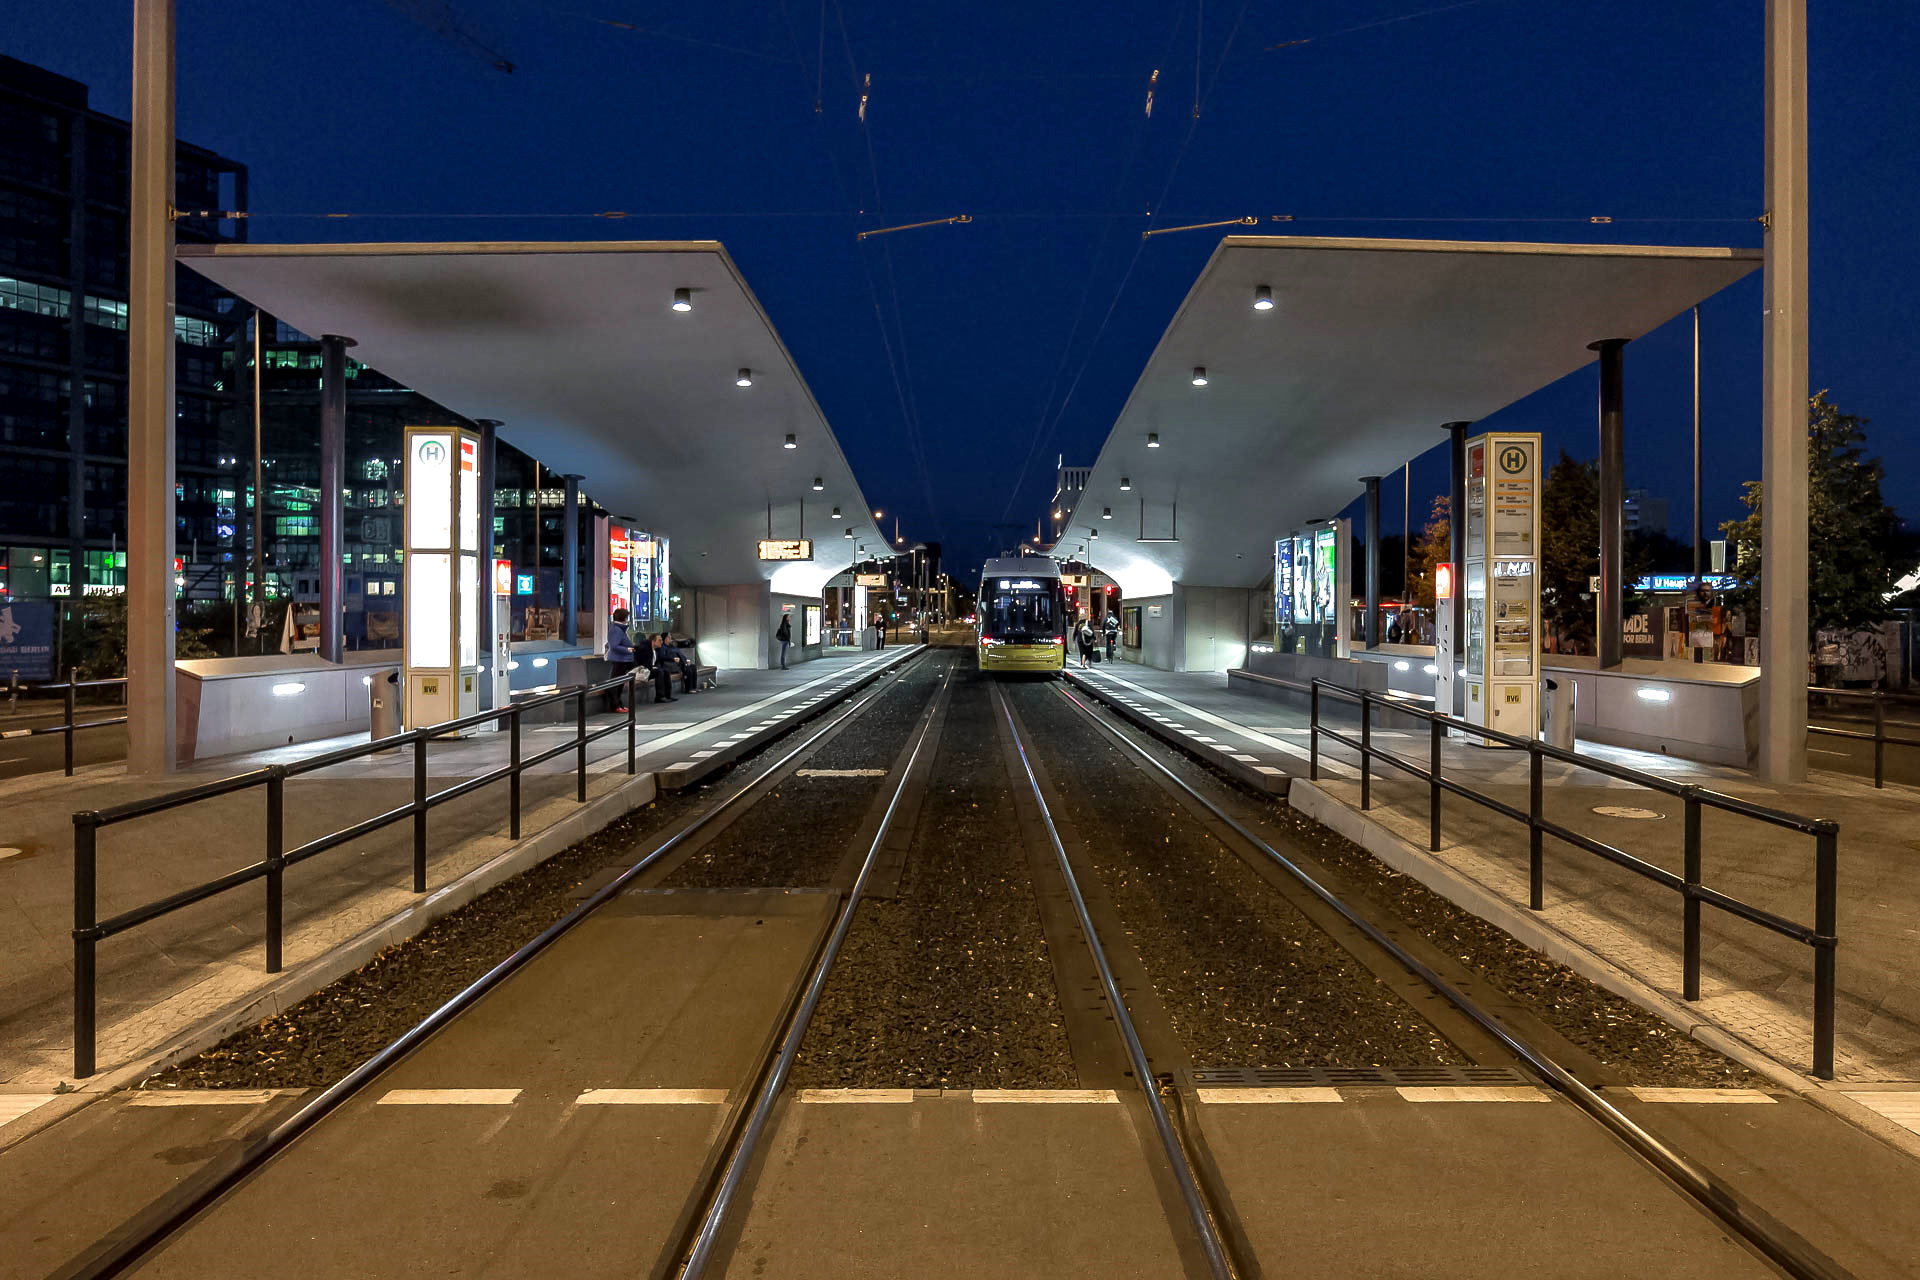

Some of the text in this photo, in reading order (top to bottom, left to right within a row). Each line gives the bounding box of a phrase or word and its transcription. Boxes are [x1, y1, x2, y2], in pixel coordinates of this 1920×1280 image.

[427, 447, 438, 460] H
[1507, 453, 1519, 467] H
[1655, 578, 1662, 587] U
[1663, 577, 1721, 588] Hauptof
[1636, 635, 1653, 643] BERLIN
